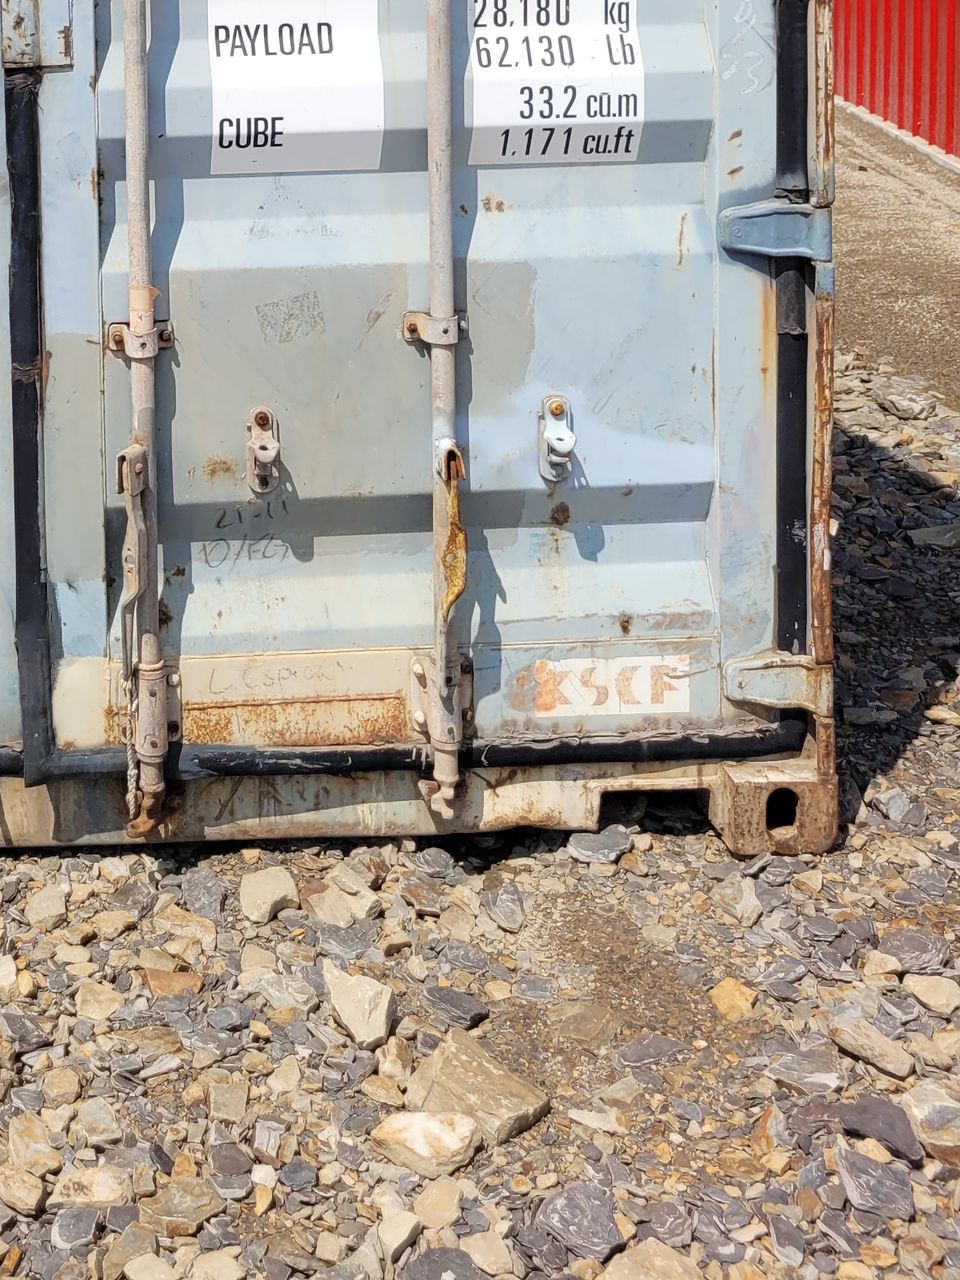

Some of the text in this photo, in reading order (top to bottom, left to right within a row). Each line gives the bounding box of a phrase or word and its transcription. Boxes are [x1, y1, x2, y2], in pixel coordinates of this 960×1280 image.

[214, 22, 335, 58] PAYLOAD
[606, 34, 636, 66] Lb
[519, 85, 577, 120] 33.2
[218, 116, 284, 149] CUBE
[500, 126, 634, 157] 1,171 cu.ft
